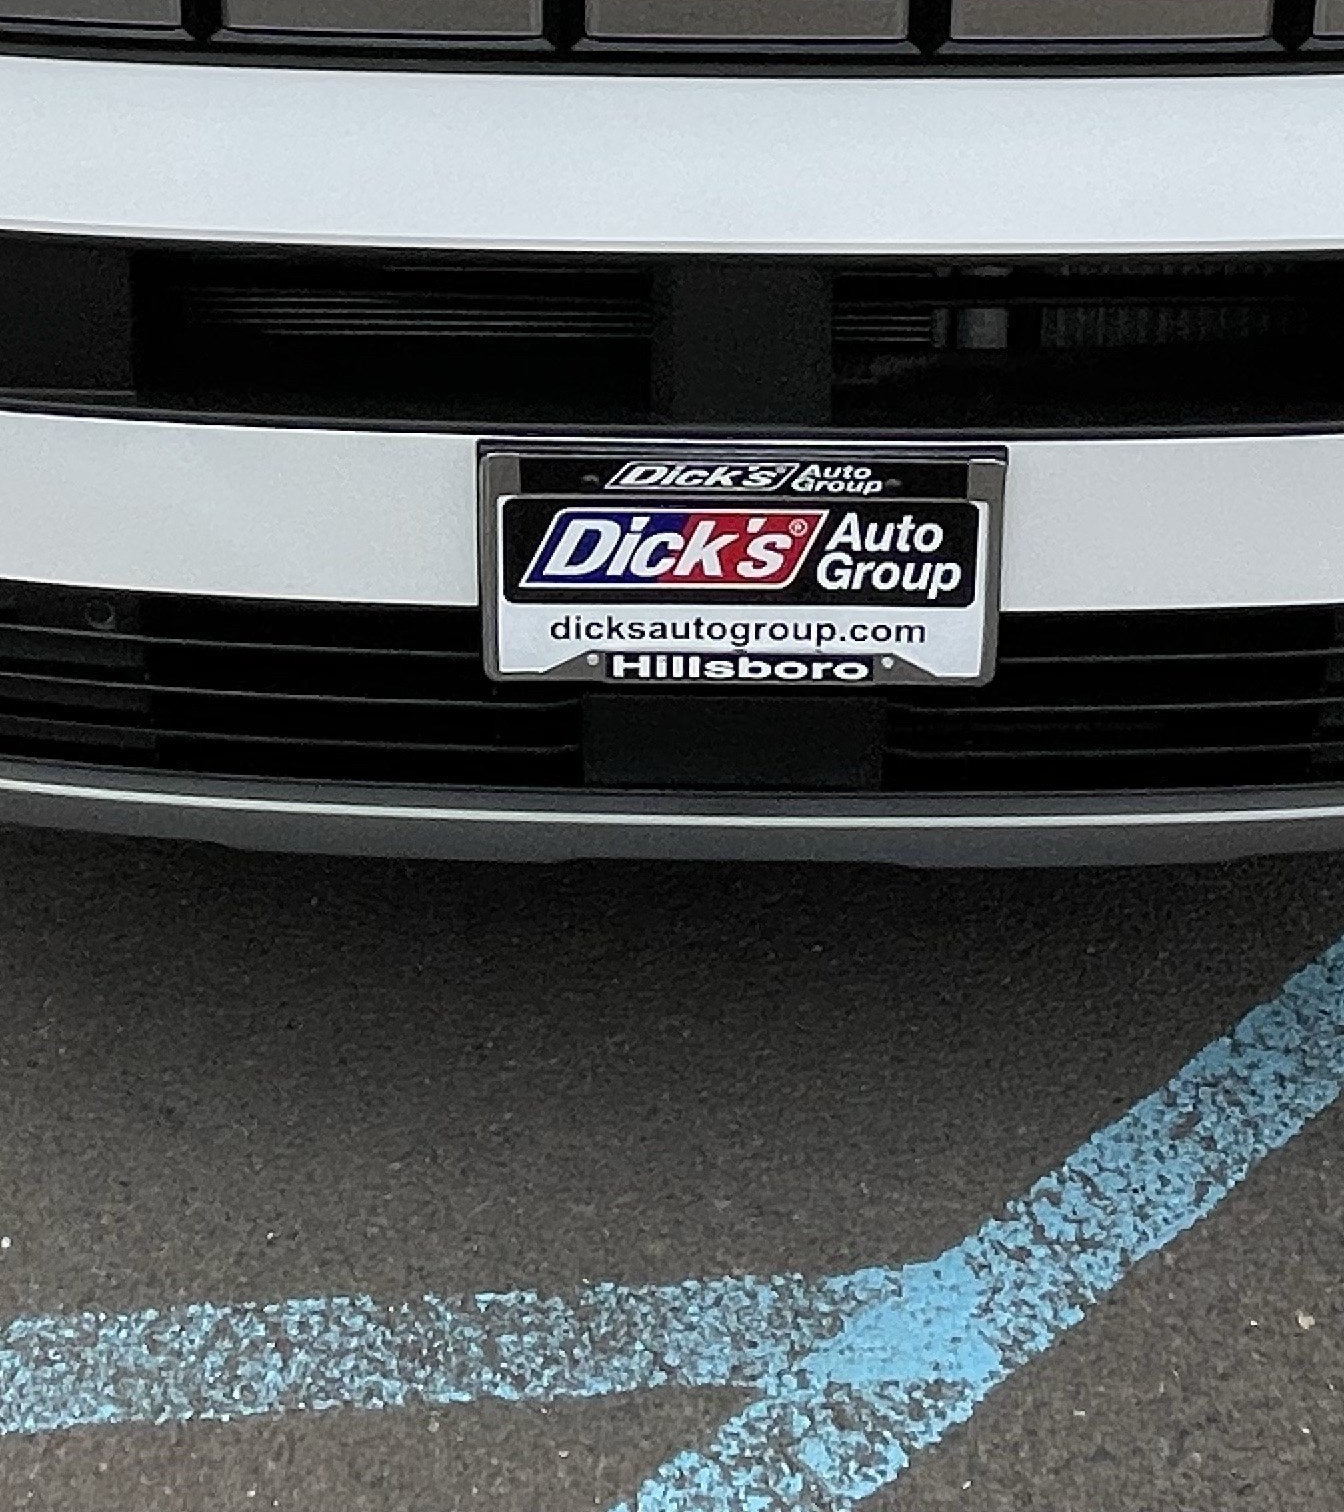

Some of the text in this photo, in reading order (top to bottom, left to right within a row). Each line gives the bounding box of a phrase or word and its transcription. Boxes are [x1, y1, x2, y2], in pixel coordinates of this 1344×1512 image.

[618, 463, 778, 487] Dick's
[799, 464, 872, 479] Auto
[791, 478, 883, 495] Group
[542, 516, 792, 578] Dick's
[825, 513, 944, 553] Auto
[816, 553, 961, 599] Group
[550, 615, 926, 646] dicksautogroup.com
[611, 655, 870, 681] Hillsboro
